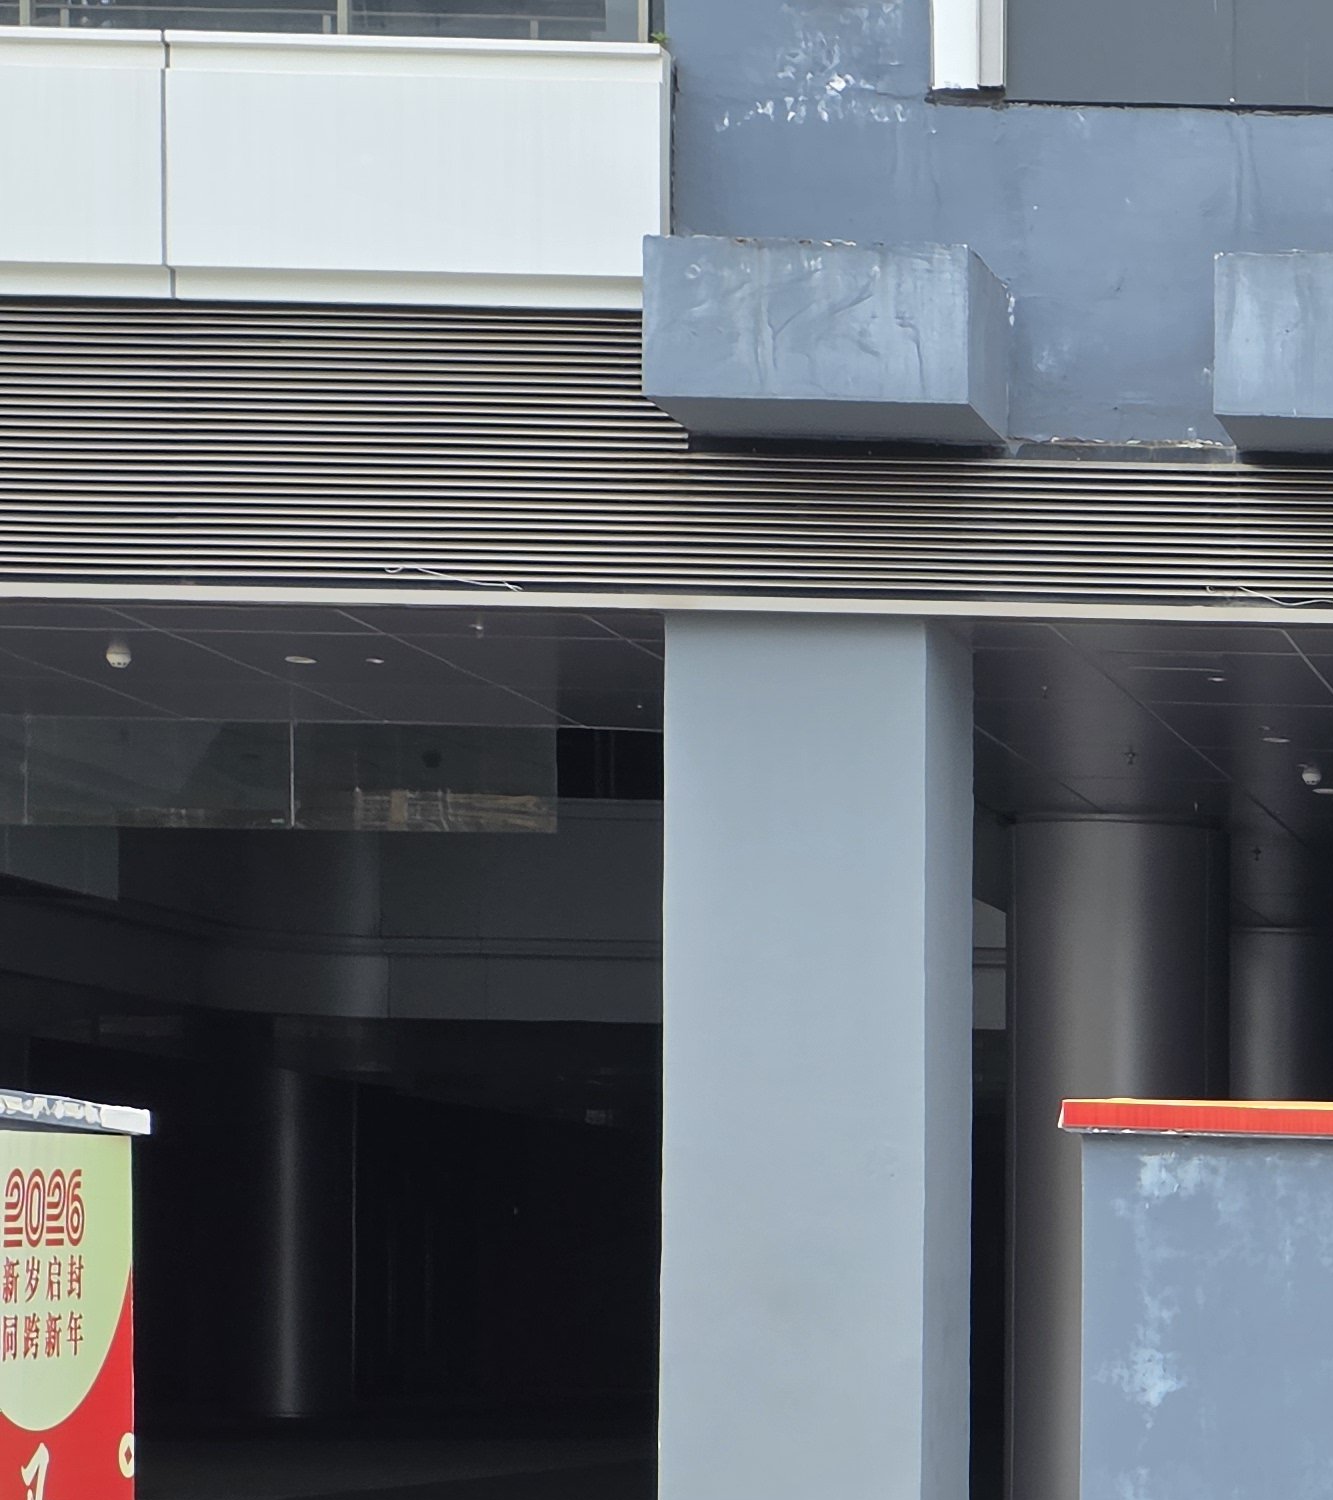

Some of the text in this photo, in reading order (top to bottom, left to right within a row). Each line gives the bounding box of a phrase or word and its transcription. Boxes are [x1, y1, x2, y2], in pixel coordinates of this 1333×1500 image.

[3, 1168, 85, 1248] 2026
[2, 1254, 84, 1304] 新岁启封
[2, 1310, 84, 1362] 同跨新年
